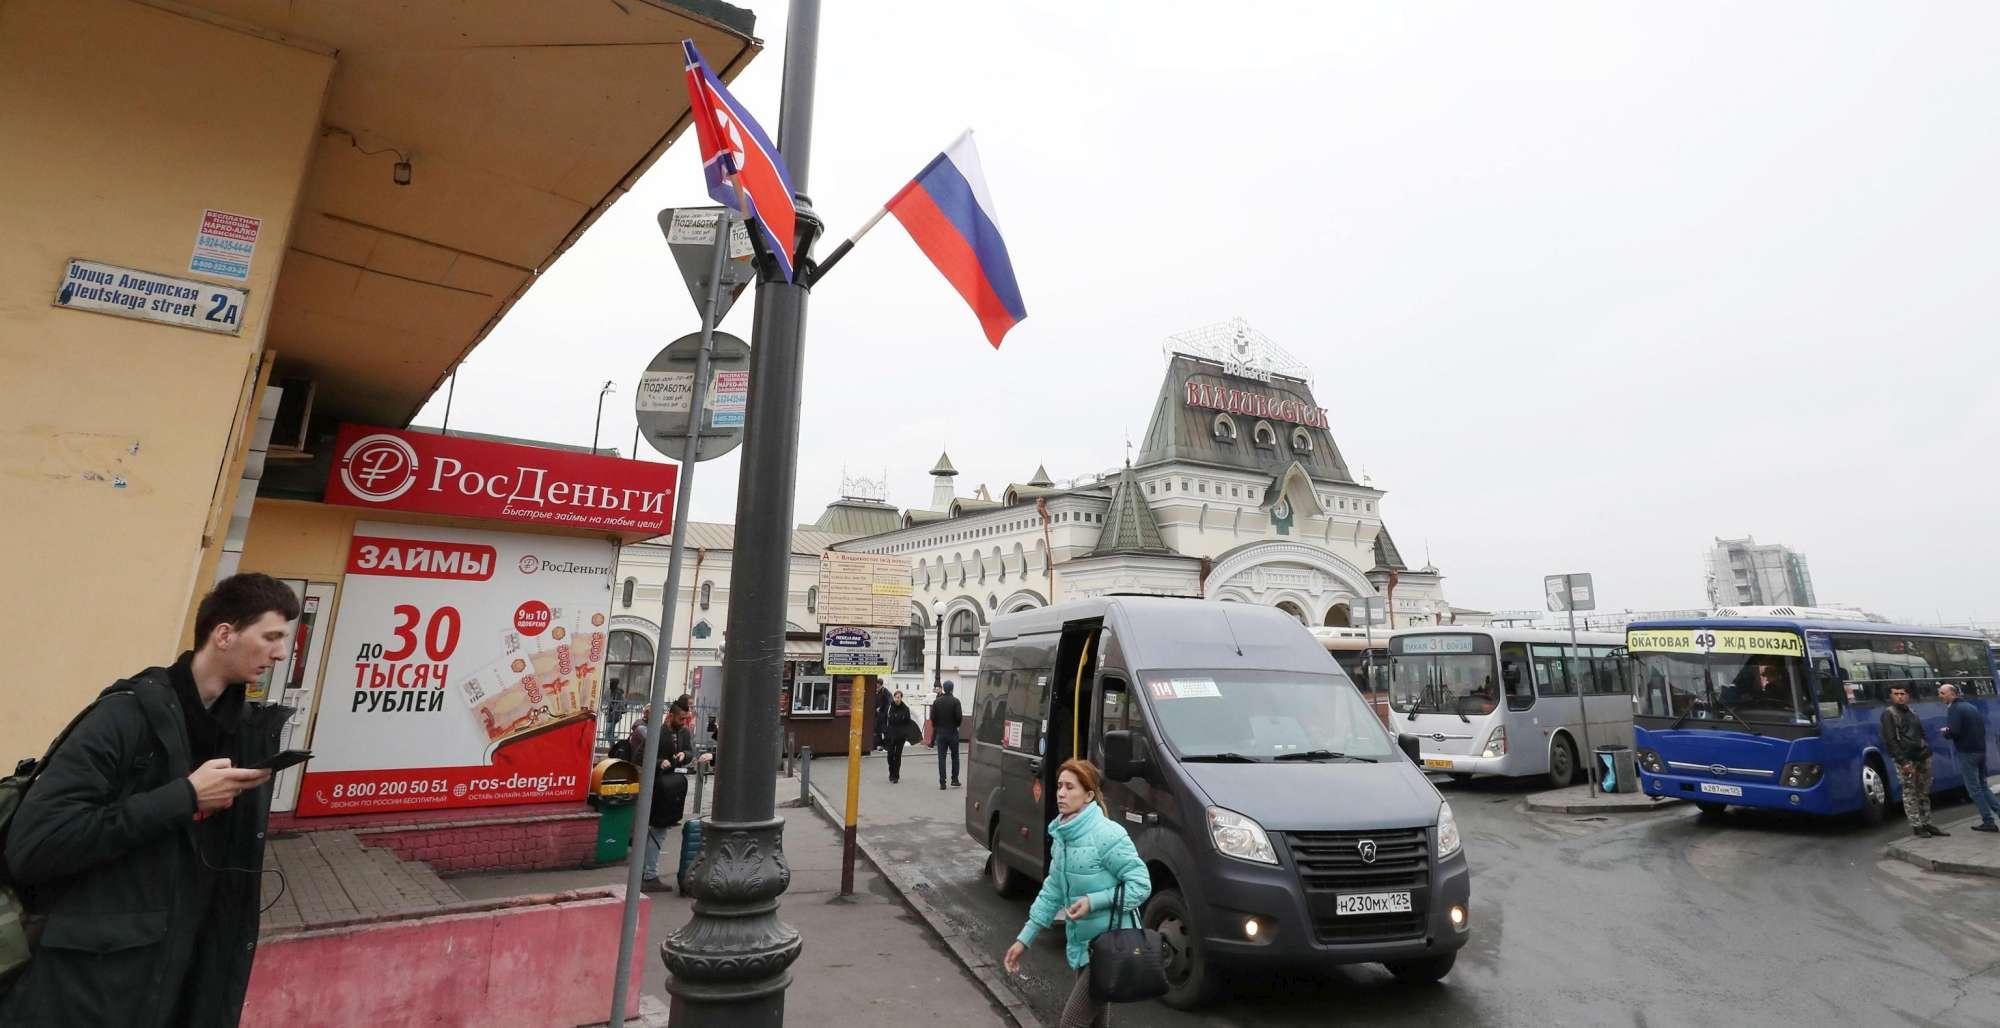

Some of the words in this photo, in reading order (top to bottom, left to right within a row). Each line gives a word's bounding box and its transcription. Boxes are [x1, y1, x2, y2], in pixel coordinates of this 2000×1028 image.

[206, 211, 260, 224] БЕСПЛАТНАЯ
[69, 264, 113, 286] Улица
[118, 273, 200, 301] Алеутская
[151, 298, 198, 318] street
[205, 293, 239, 325] 2А
[643, 383, 692, 394] ПОДРАБОТКА
[1186, 381, 1329, 430] ВЛАДИВОСТОК
[427, 456, 665, 515] РосДеньги
[502, 505, 553, 520] Быстрые
[555, 511, 587, 523] займы
[589, 516, 602, 524] на
[603, 516, 635, 527] любые
[637, 519, 663, 530] цели!
[356, 545, 490, 576] ЗАЙМЫ
[541, 560, 608, 575] РосДеньги
[518, 609, 525, 620] 9
[536, 610, 548, 620] 10
[382, 604, 461, 662] 30
[1631, 636, 1689, 648] ОКАТОВАЯ
[1695, 634, 1716, 648] 49
[1724, 637, 1746, 649] Ж/Д
[1749, 637, 1798, 650] ВОКЗАЛ
[1430, 639, 1443, 650] 31
[355, 662, 448, 689] ТЫСЯЧ
[1152, 681, 1173, 696] 114
[351, 686, 445, 713] РУБЛЕЙ
[332, 784, 343, 798] 8
[346, 782, 376, 798] 800
[379, 780, 408, 796] 200
[409, 780, 430, 794] 50
[431, 779, 449, 793] 51
[469, 772, 577, 792] ros-dengi.ru
[361, 798, 372, 808] ПО
[1340, 896, 1389, 912] Н230МХ
[1390, 893, 1409, 906] 125
